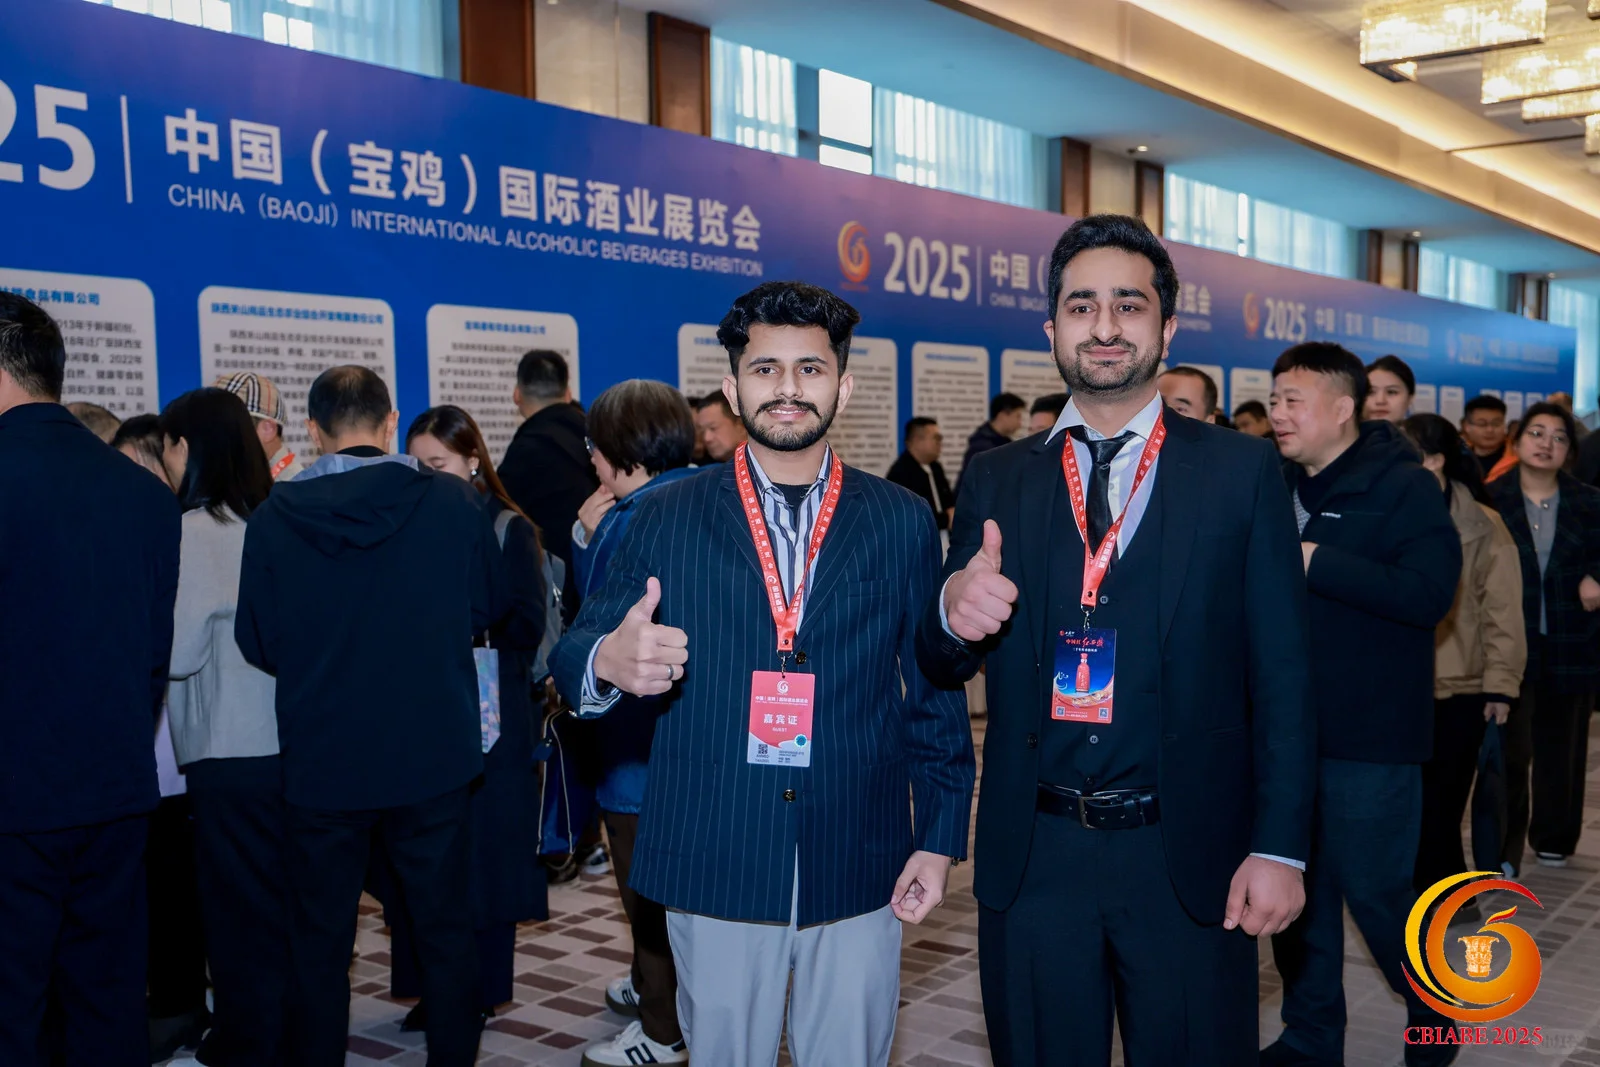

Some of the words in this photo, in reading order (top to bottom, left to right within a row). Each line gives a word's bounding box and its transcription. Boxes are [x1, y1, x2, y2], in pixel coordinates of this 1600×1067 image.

[164, 108, 762, 252] 中国（宝鸡）国际酒业展览会
[168, 184, 245, 215] CHINA
[351, 208, 501, 247] INTERNATIONAL
[504, 229, 599, 258] ALCOHOLIC
[601, 240, 689, 269] BEVERAGES
[690, 254, 763, 277] EXHIBITION
[883, 231, 972, 302] 2025
[1264, 298, 1307, 342] 2025
[764, 713, 798, 725] 嘉宾证
